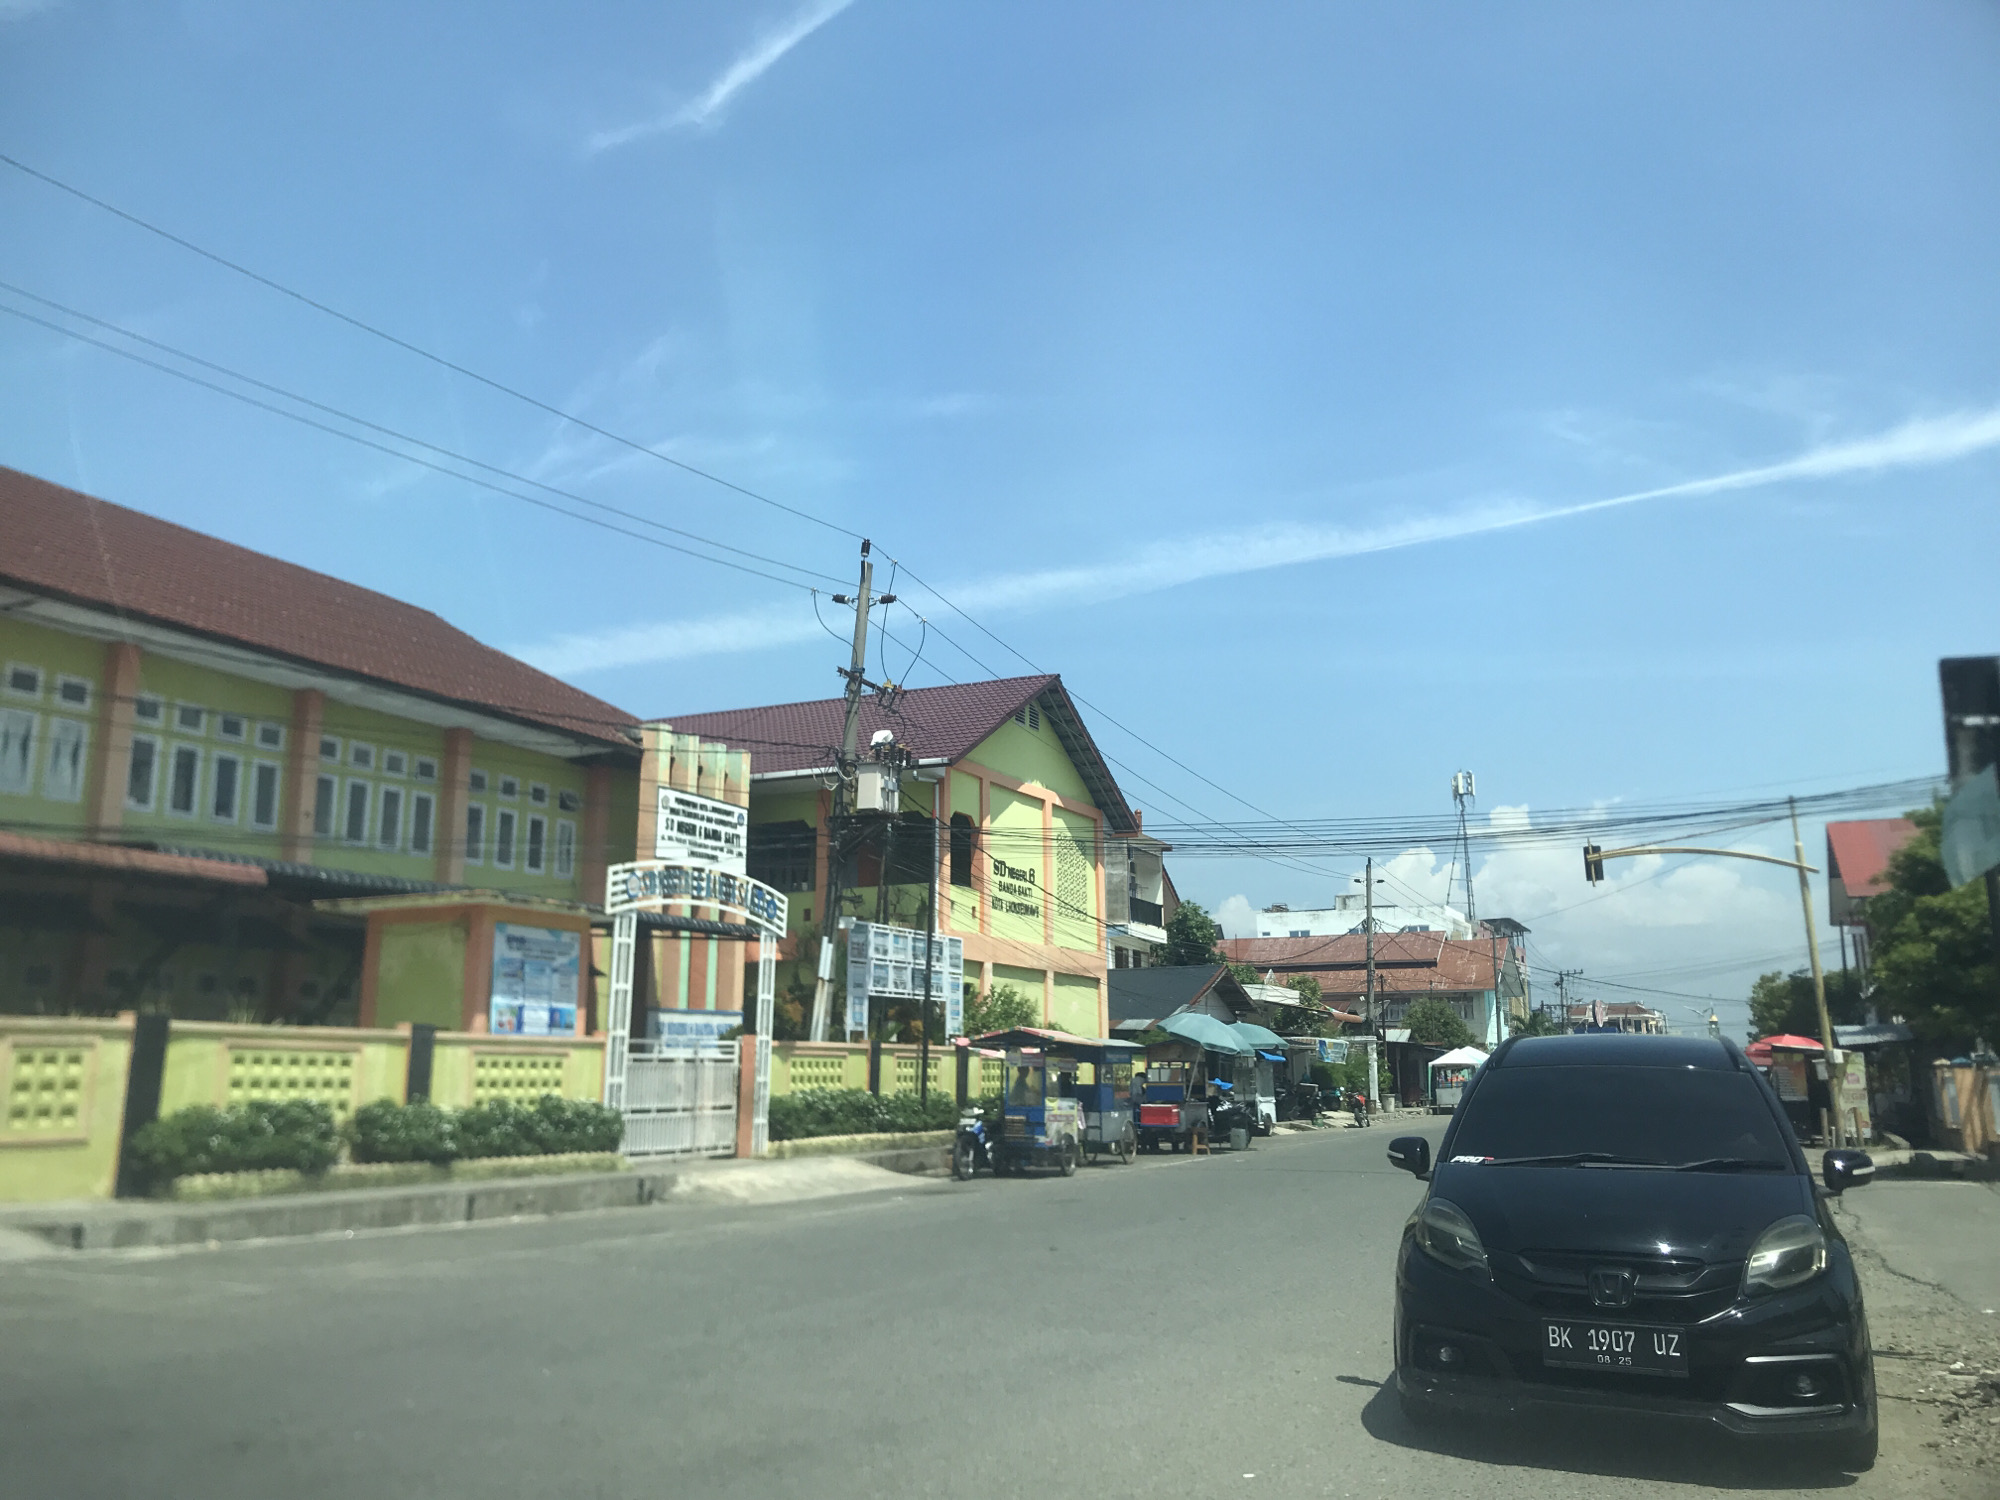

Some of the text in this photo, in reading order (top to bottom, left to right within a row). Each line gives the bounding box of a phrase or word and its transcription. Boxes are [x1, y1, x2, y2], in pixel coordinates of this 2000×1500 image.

[993, 859, 1006, 877] SD
[998, 880, 1017, 896] BANDA
[1548, 1325, 1681, 1357] BK 1907 UZ
